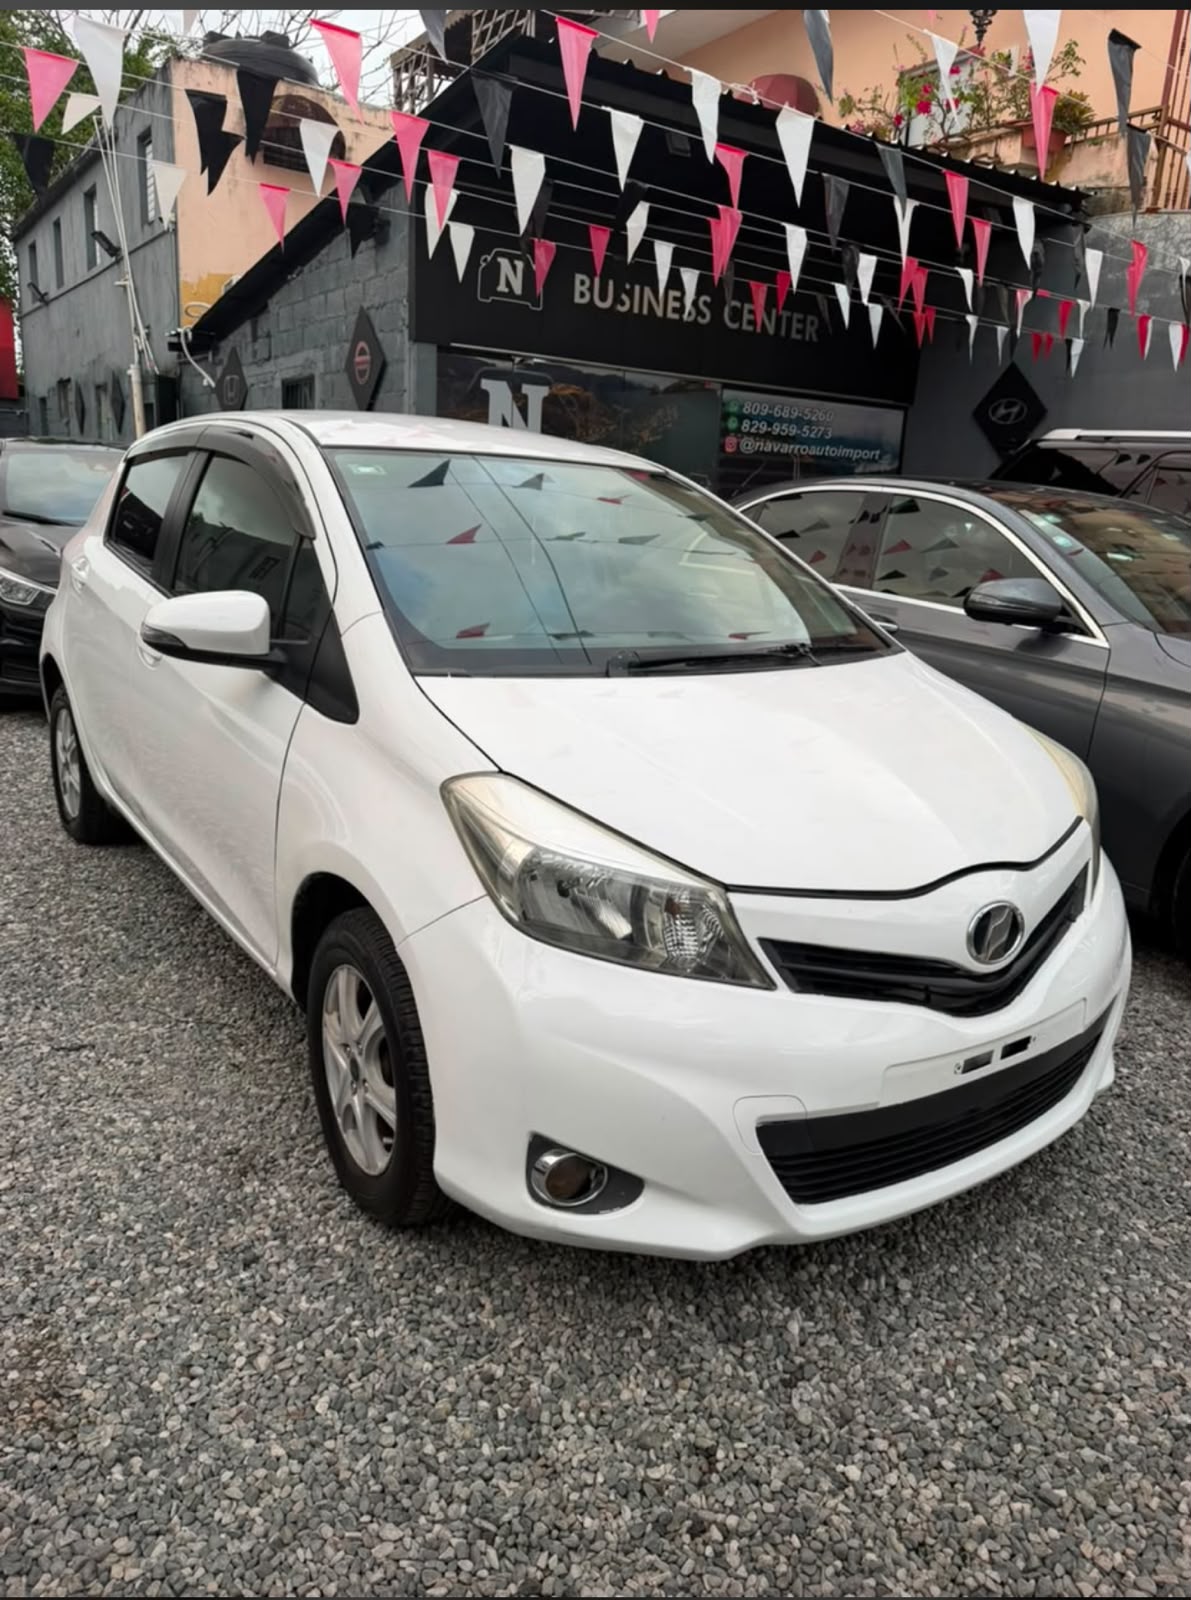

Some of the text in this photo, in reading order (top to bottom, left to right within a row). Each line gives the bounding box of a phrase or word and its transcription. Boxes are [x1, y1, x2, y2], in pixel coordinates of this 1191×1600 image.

[496, 257, 525, 297] N
[723, 299, 819, 343] CENTER
[742, 401, 834, 422] 809-689-5260
[741, 419, 833, 439] 829-959-5273
[739, 437, 881, 461] @navarroautoimport
